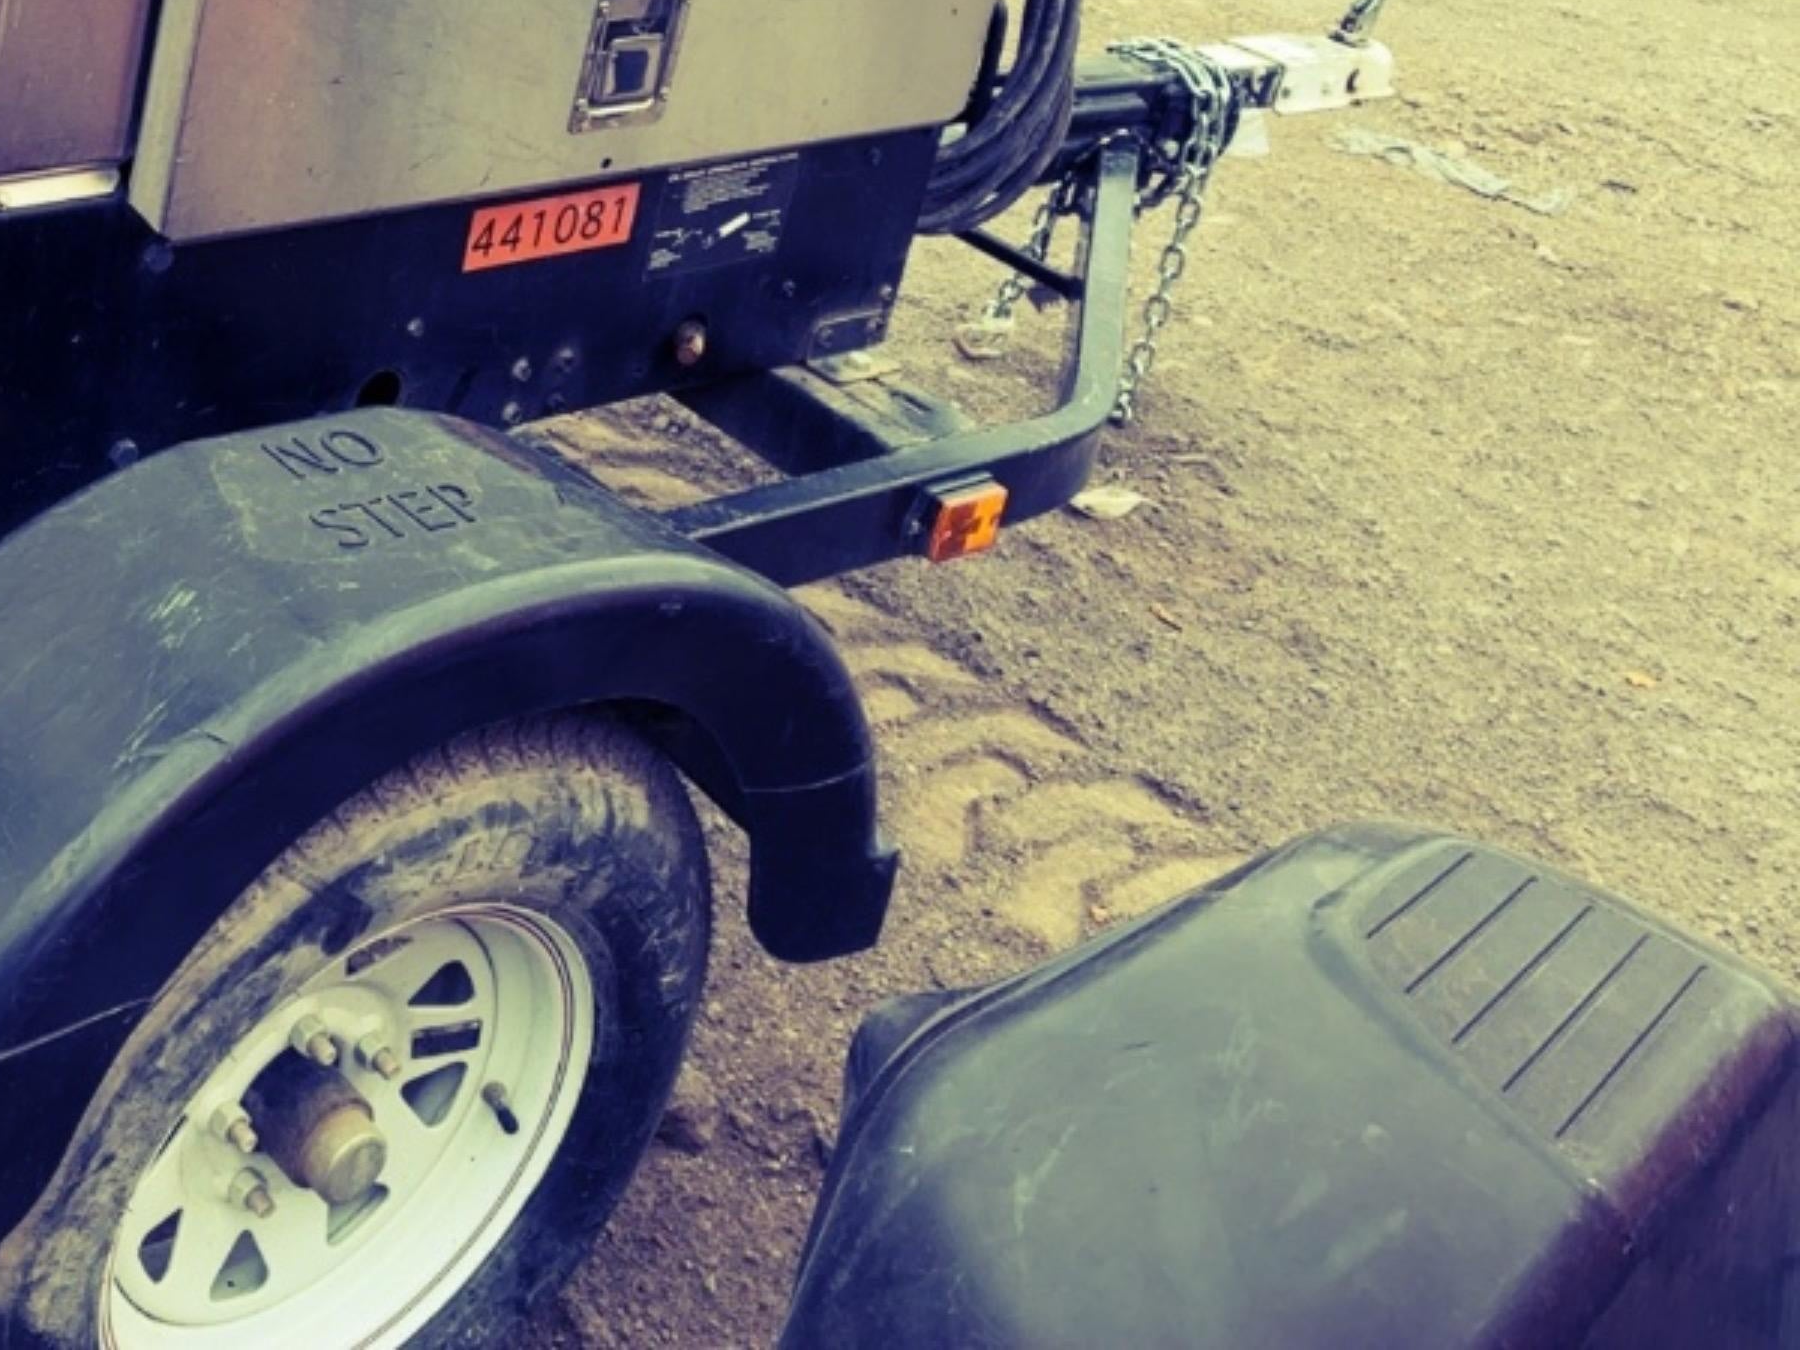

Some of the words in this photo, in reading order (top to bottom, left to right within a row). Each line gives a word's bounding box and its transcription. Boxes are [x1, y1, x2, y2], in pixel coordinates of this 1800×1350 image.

[471, 195, 628, 260] 441081
[259, 429, 385, 480] NO
[307, 482, 477, 548] STEP
